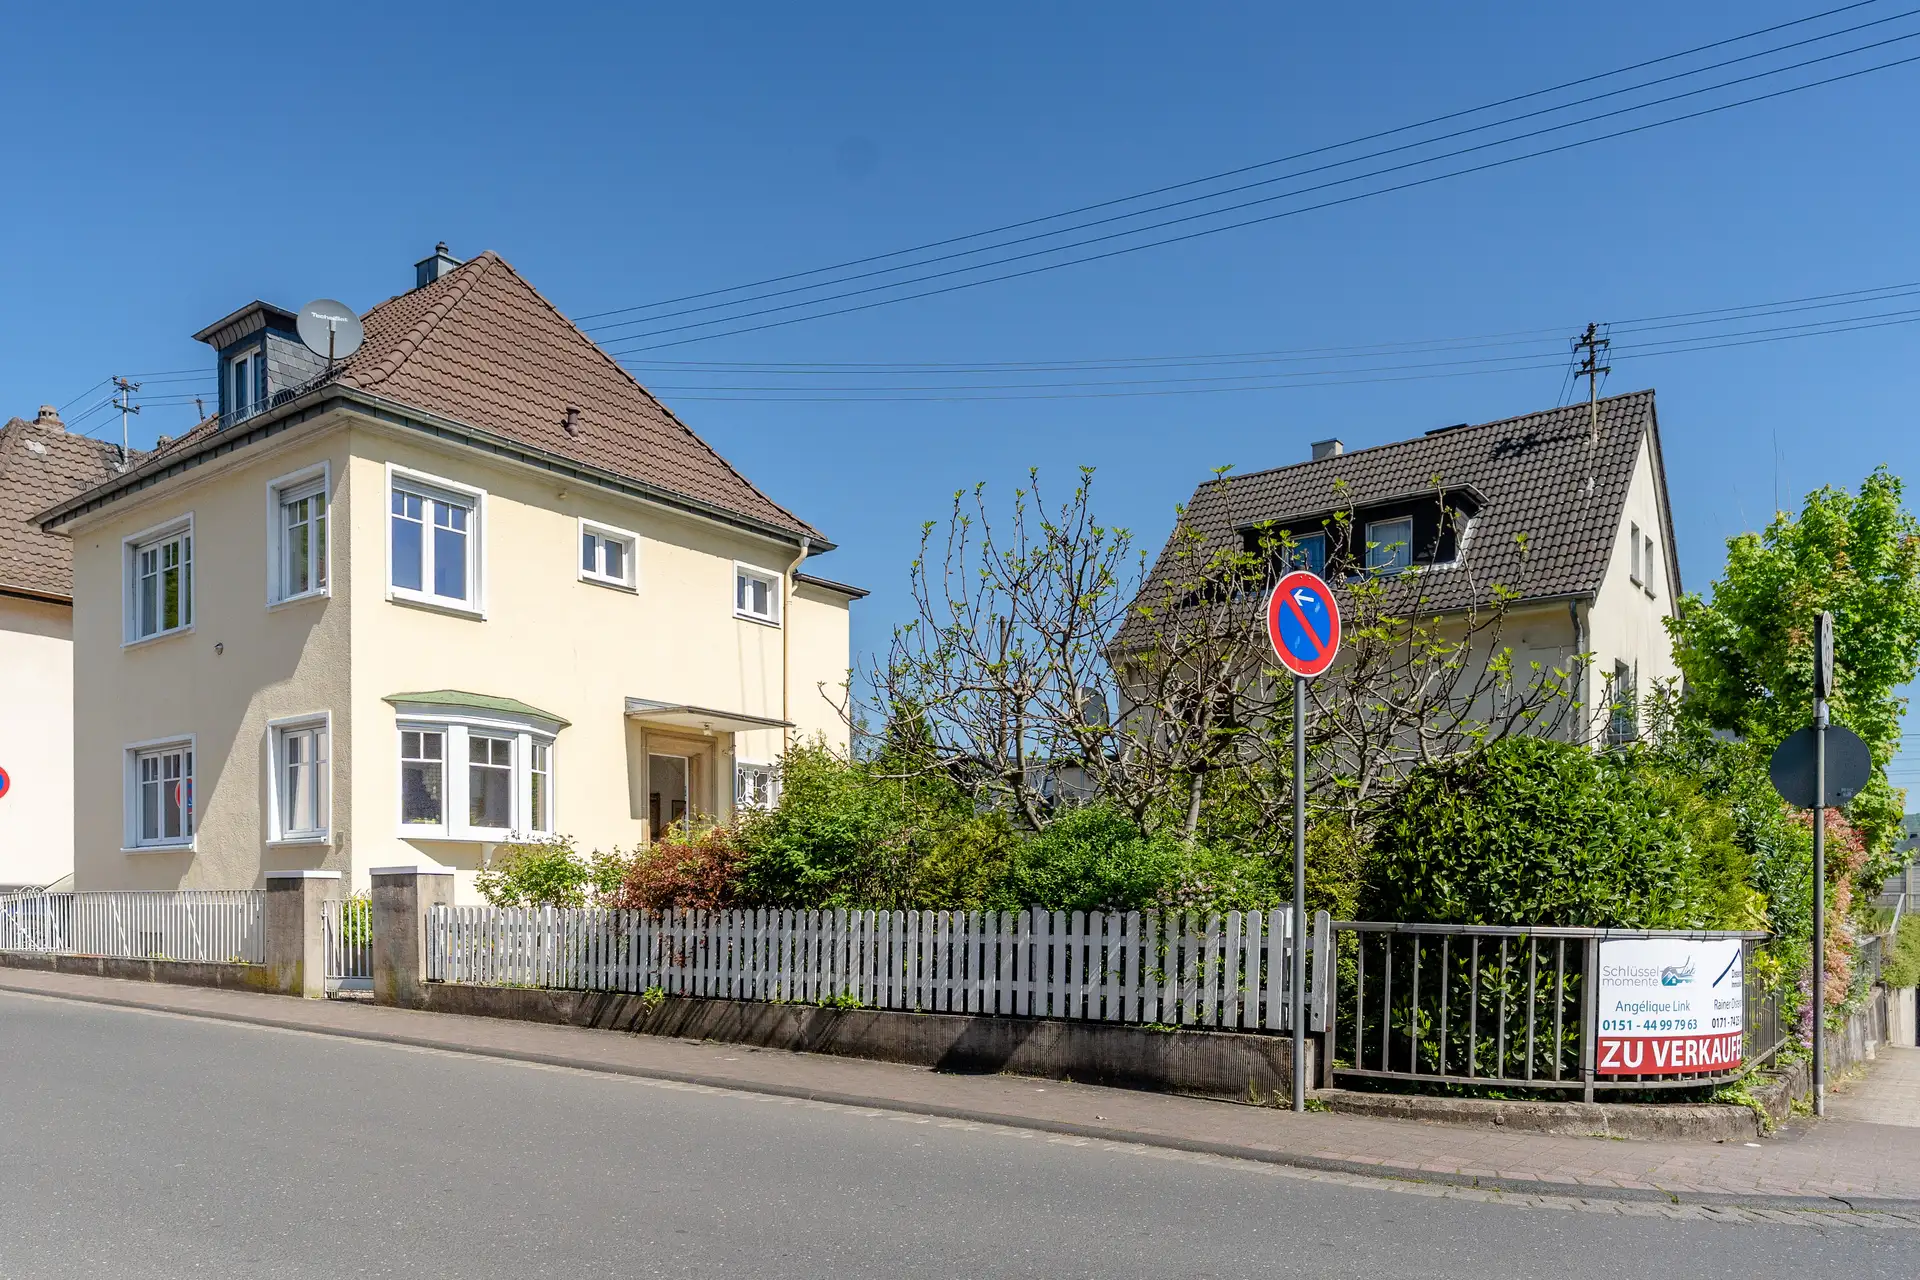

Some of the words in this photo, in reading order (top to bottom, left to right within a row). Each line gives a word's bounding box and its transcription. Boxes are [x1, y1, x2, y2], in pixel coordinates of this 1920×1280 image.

[1602, 977, 1659, 987] momente
[1615, 1000, 1671, 1015] Angélique
[1673, 999, 1690, 1012] Link
[1602, 1019, 1632, 1031] 0151
[1711, 1017, 1727, 1029] 0171
[1600, 1040, 1644, 1068] ZU
